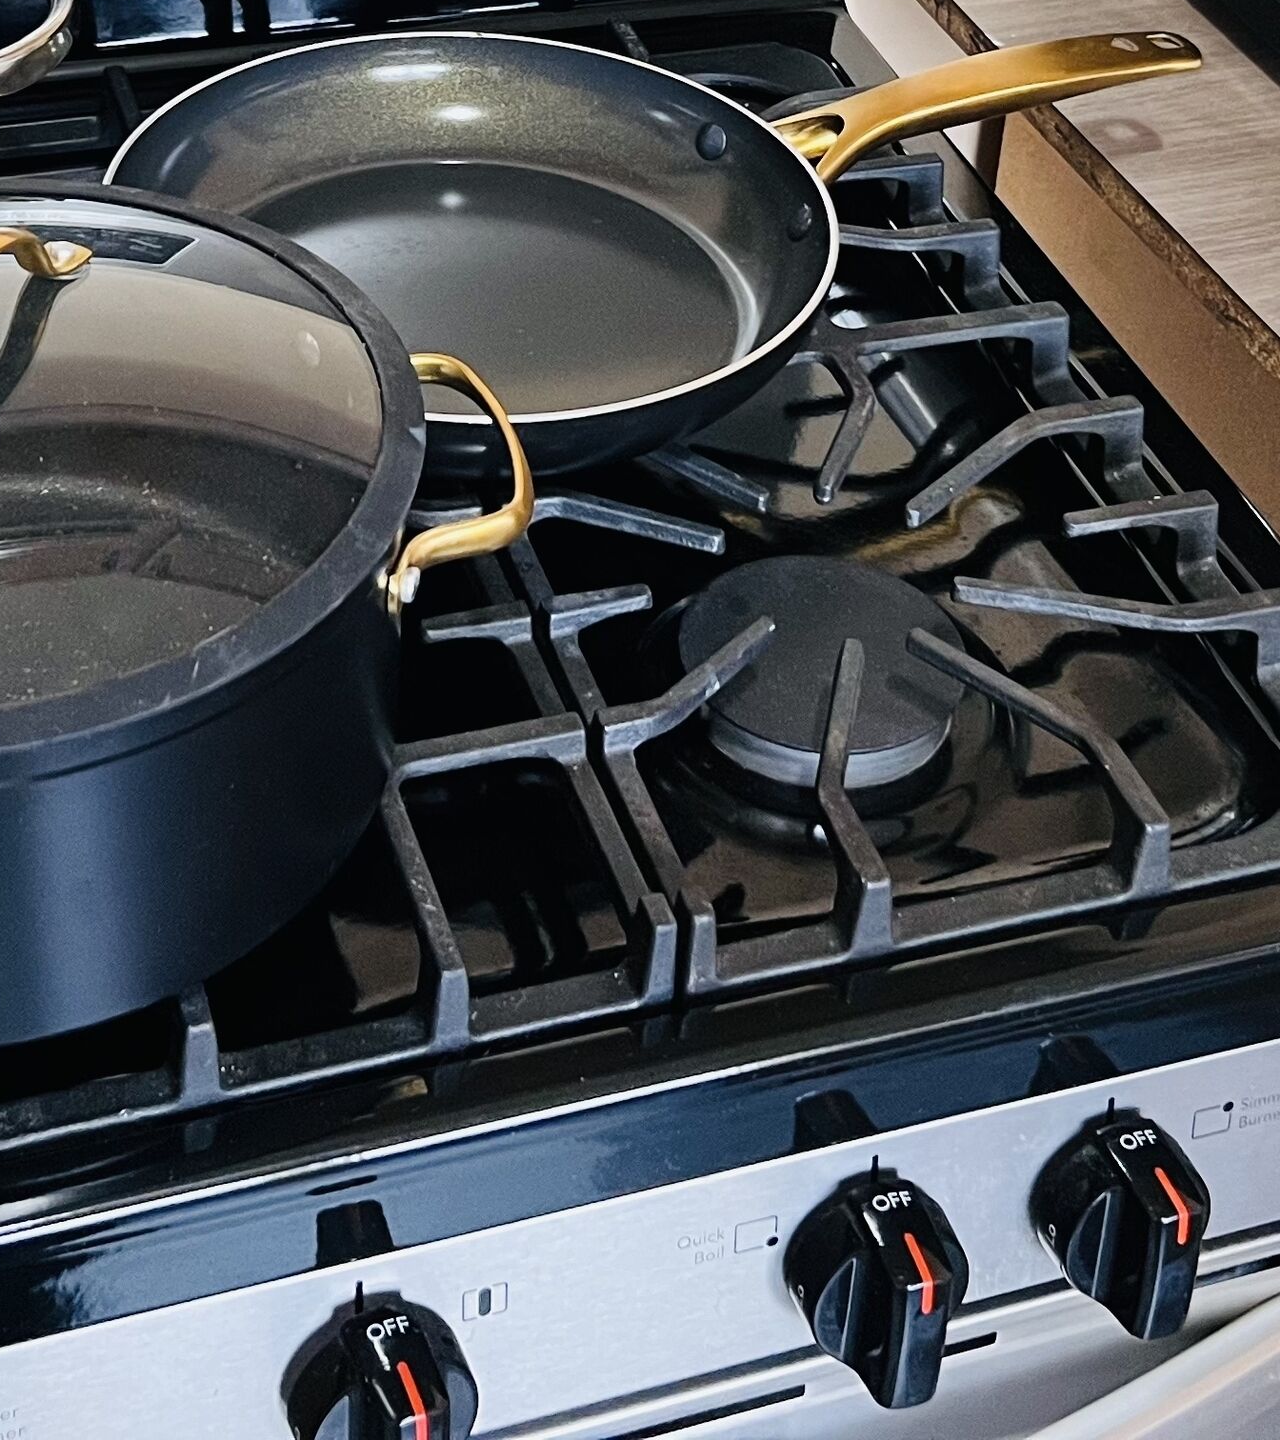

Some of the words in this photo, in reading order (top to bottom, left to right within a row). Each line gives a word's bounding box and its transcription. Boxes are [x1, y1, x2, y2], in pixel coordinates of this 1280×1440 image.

[1119, 1128, 1157, 1151] OFF
[871, 1190, 913, 1212] OFF
[676, 1227, 725, 1250] Quick
[693, 1244, 725, 1266] Boil
[365, 1315, 410, 1341] OFF
